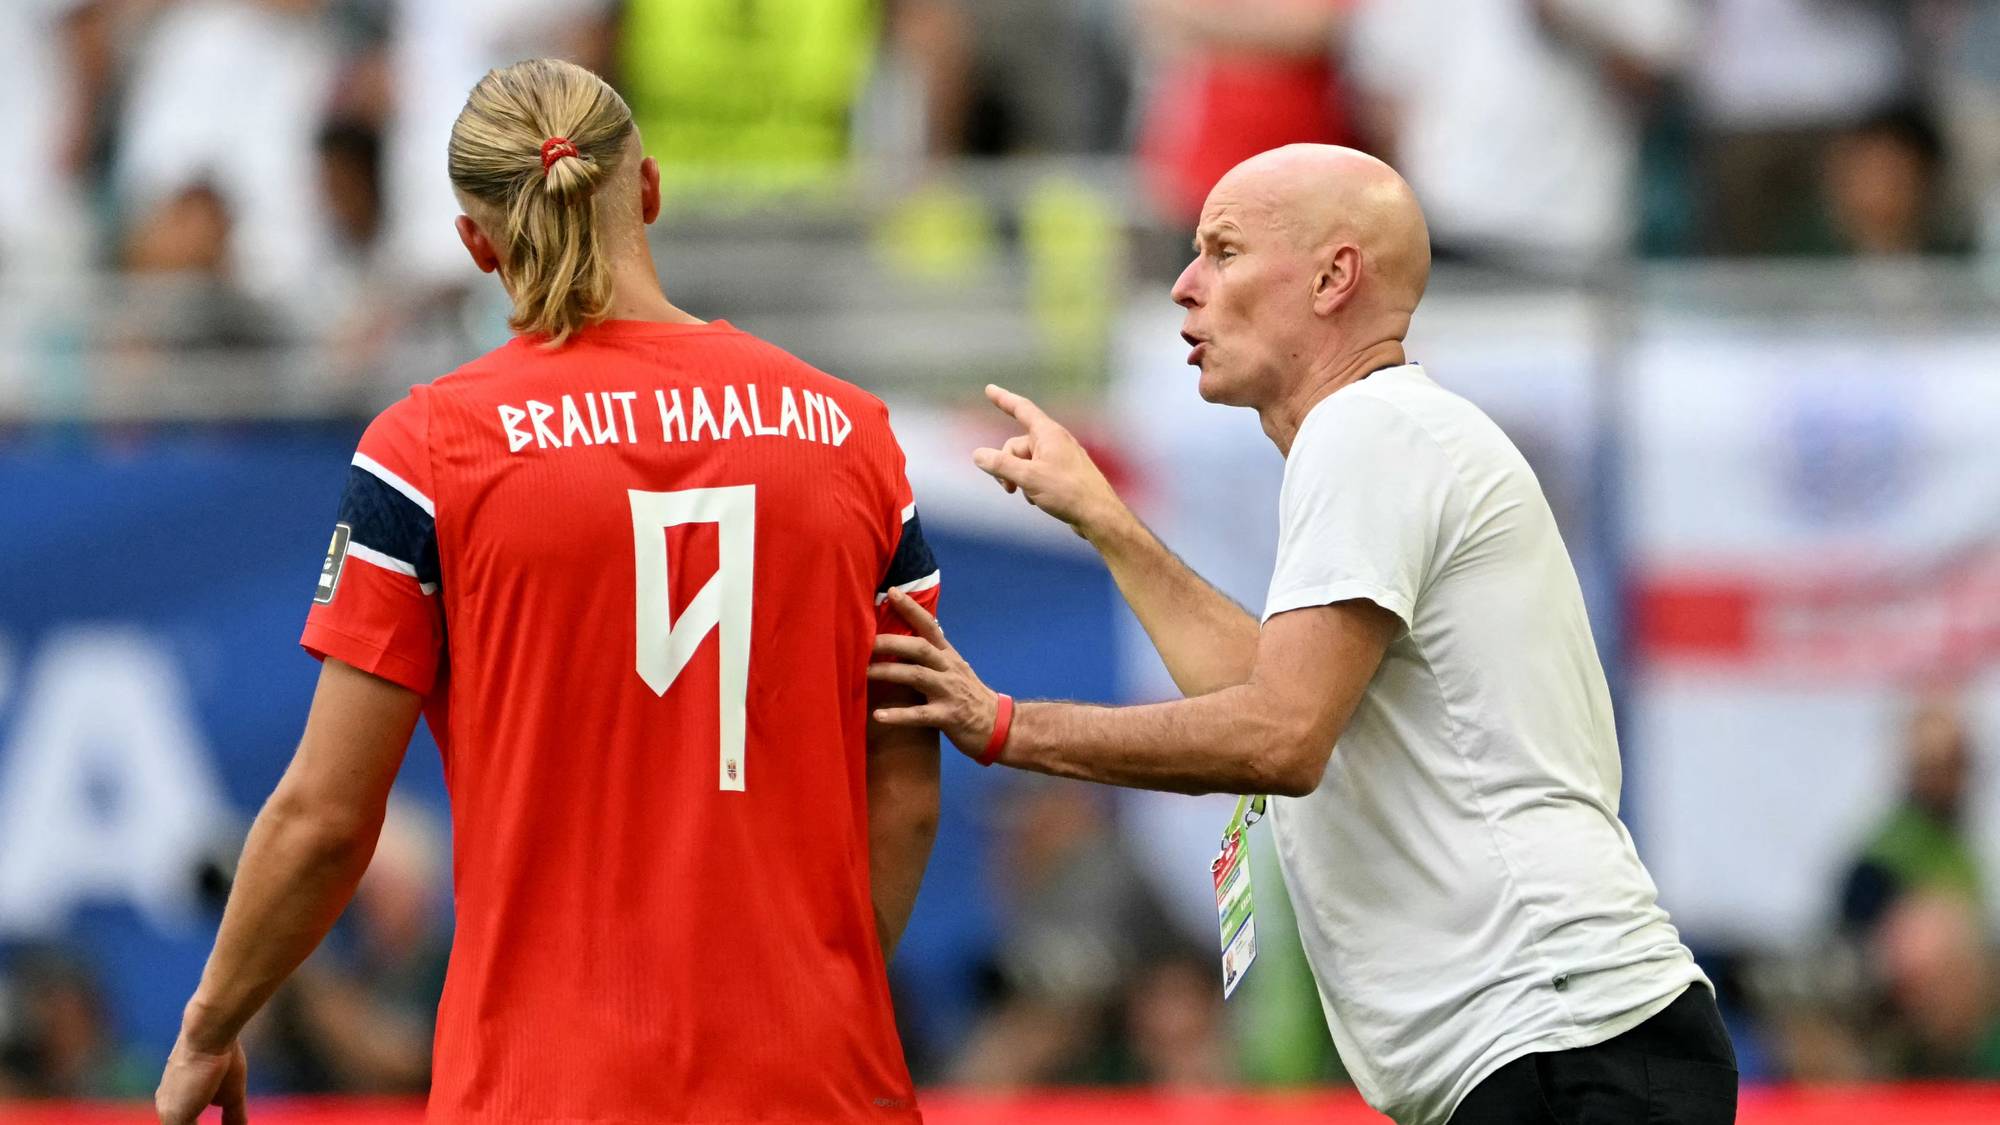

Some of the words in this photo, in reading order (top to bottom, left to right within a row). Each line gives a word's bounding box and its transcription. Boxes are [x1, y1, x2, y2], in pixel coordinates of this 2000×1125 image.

[497, 391, 638, 452] BRAUT
[655, 384, 852, 446] HAALAND
[628, 484, 756, 791] 9
